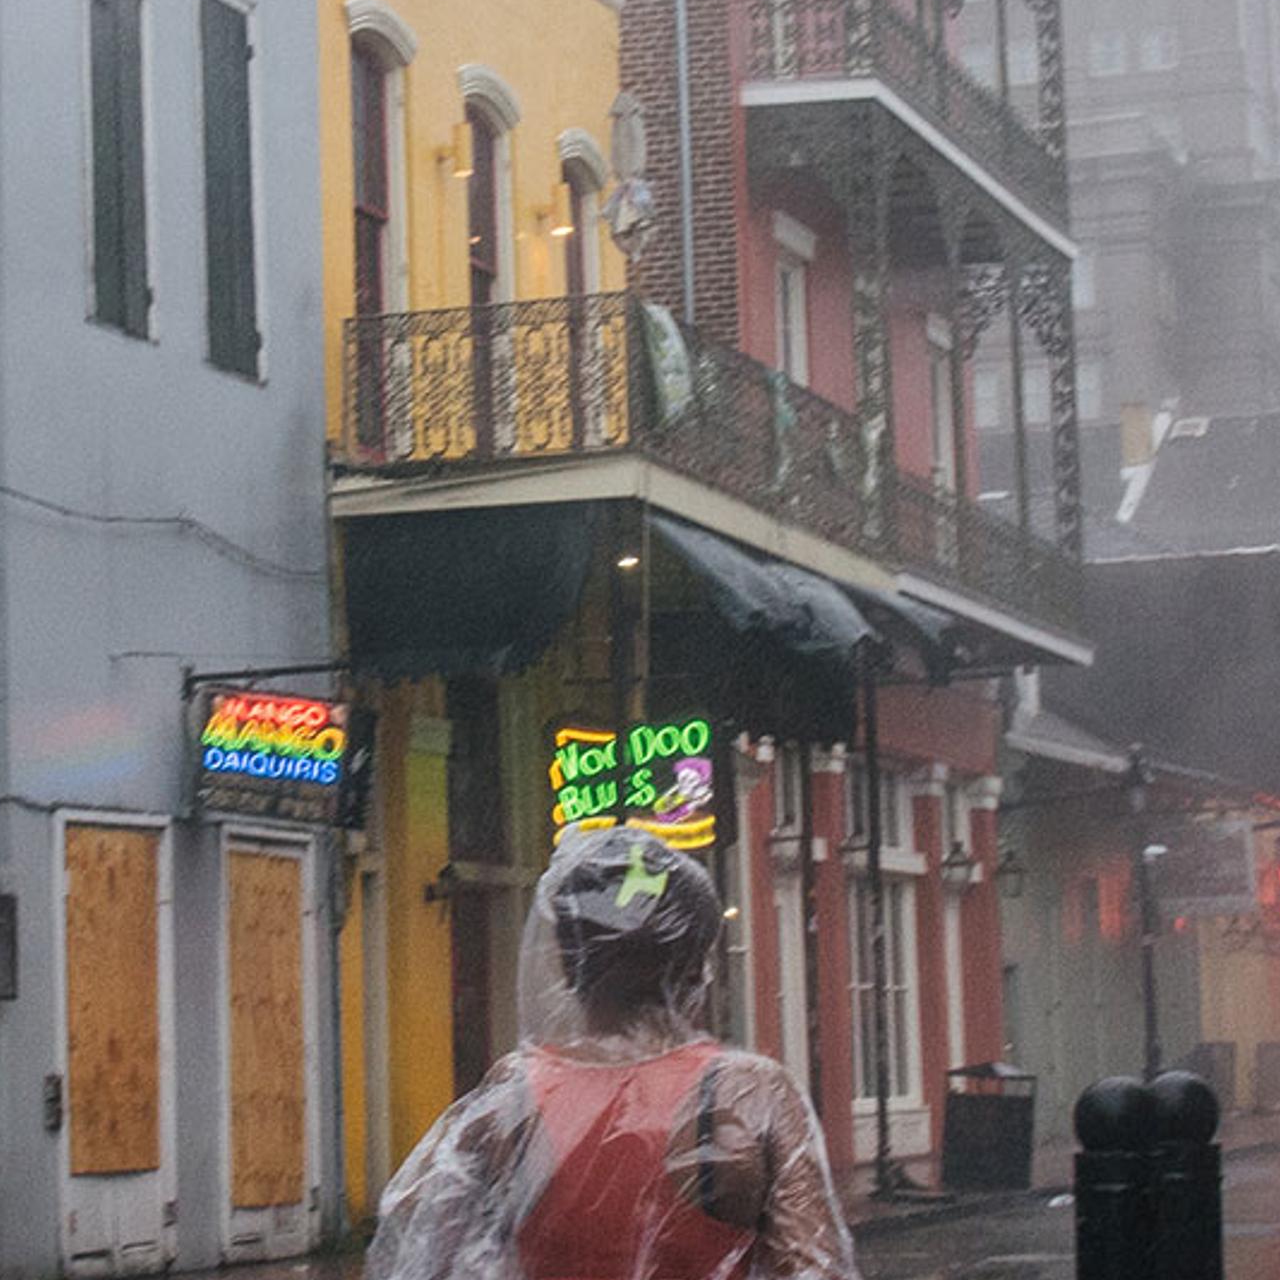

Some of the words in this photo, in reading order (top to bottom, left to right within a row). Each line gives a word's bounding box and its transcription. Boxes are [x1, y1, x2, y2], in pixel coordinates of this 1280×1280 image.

[224, 696, 329, 728] MANGO
[203, 747, 341, 784] DAIQUIRIS
[558, 768, 657, 823] BLUS
